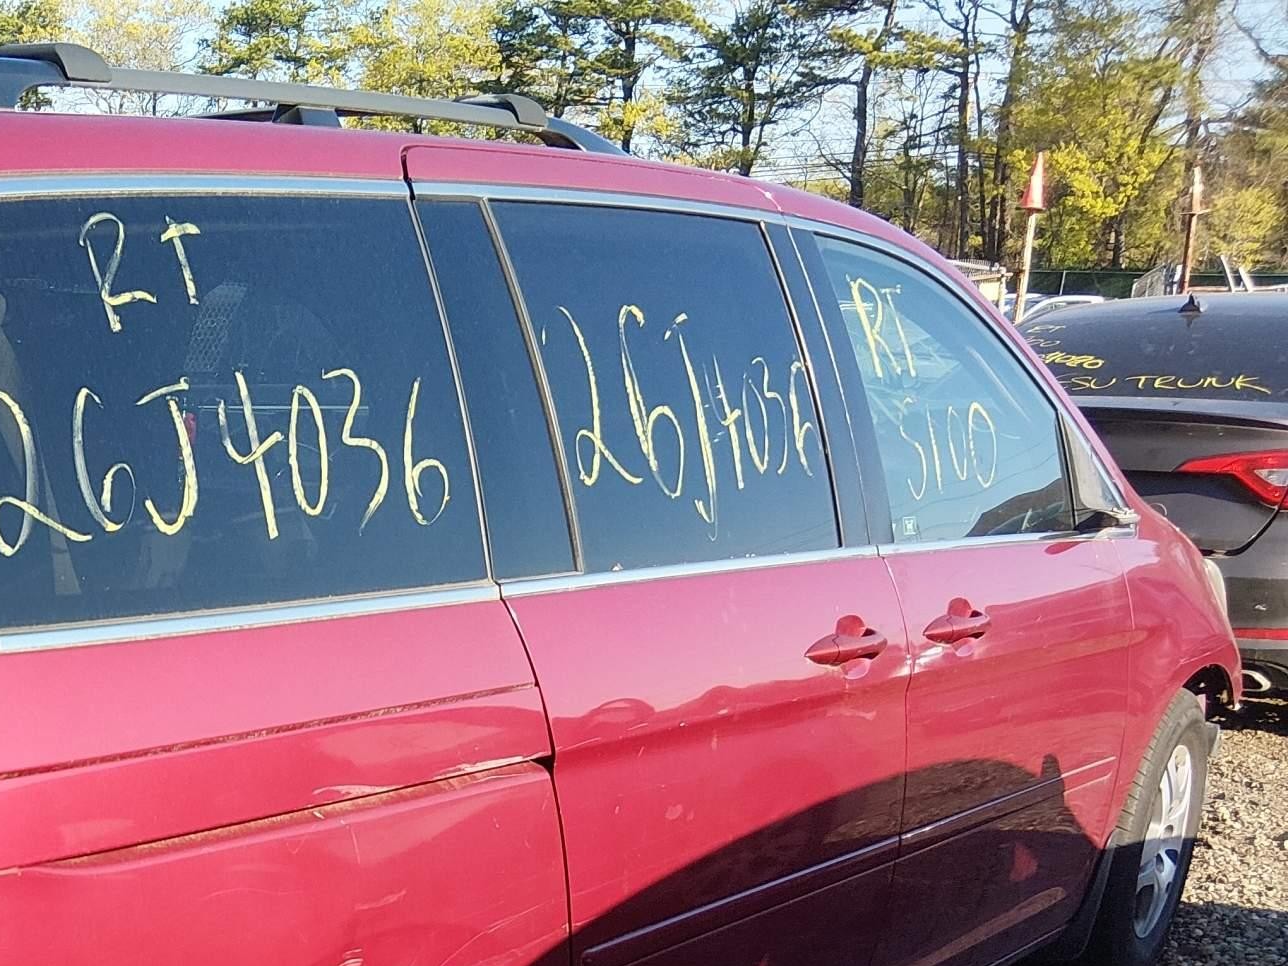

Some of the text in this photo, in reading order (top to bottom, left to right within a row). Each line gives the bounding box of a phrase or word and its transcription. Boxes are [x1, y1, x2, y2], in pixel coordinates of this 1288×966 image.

[78, 211, 201, 333] RT
[845, 273, 917, 379] RT
[1125, 374, 1272, 395] TRUNK
